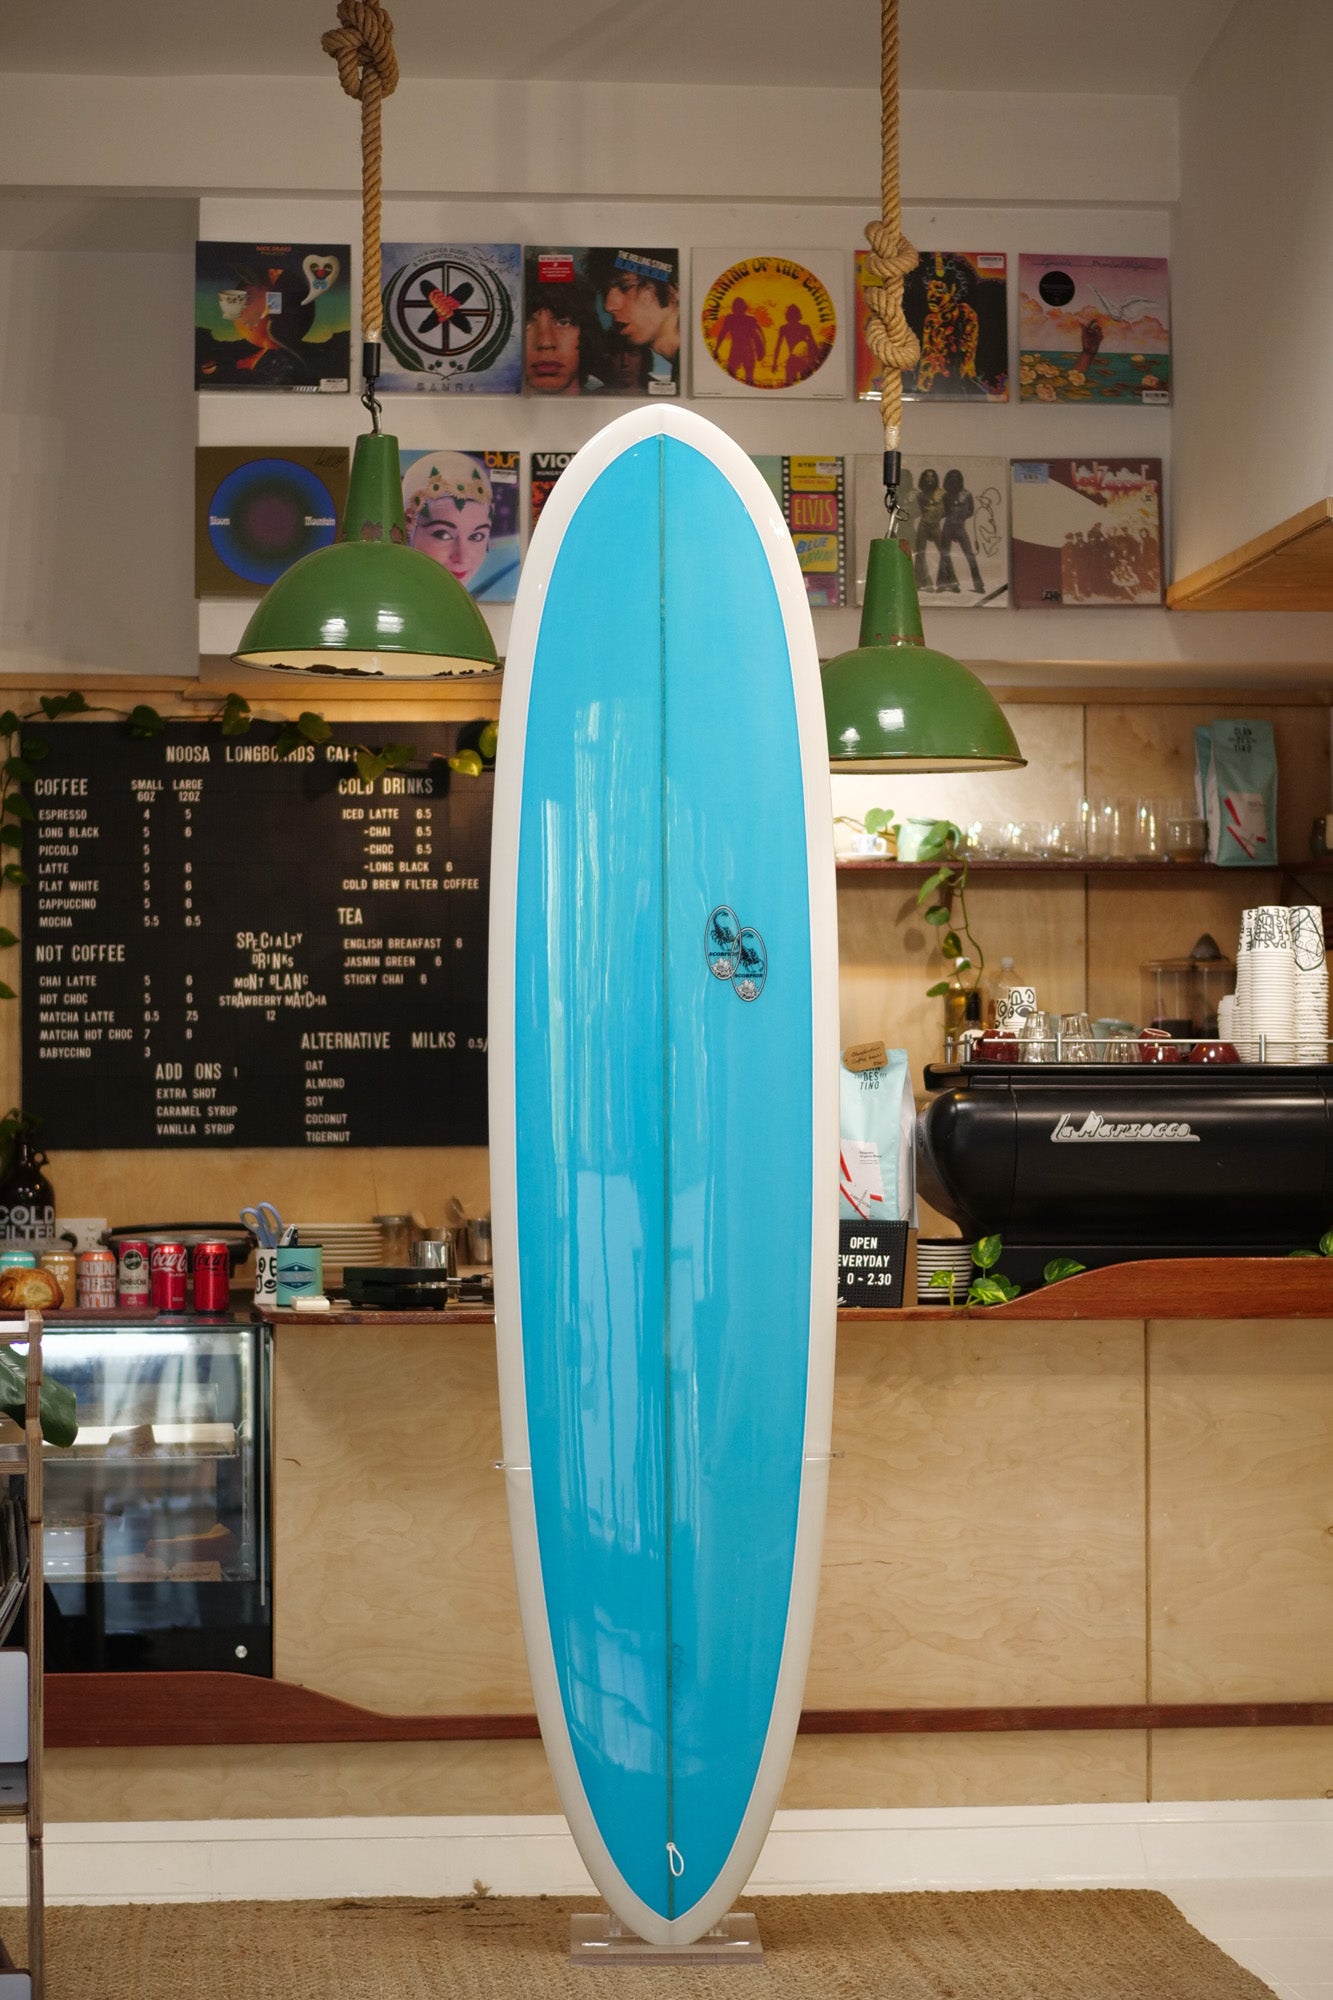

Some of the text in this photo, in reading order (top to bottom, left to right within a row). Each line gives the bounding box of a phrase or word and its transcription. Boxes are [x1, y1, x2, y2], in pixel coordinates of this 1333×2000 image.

[752, 258, 768, 273] OF
[484, 450, 519, 468] blur
[794, 499, 834, 526] ELVIS
[166, 746, 210, 762] NOOSA
[35, 779, 88, 795] COFFEE
[131, 779, 203, 791] SMALL LARGE
[338, 779, 433, 795] COLD DRINKS
[39, 809, 191, 820] ESPRESSO 4 5
[343, 808, 431, 819] ICED LATTE 6.5
[39, 827, 191, 838] LONG BLACK 5 6
[416, 826, 431, 837] 6.5
[39, 844, 150, 856] PICCOLO 5
[417, 844, 432, 854] 6.5
[39, 862, 192, 874] LATTE 5 6
[399, 862, 429, 872] BLACK
[446, 862, 453, 872] 6
[39, 880, 192, 892] FLAT WHITE 5 6
[343, 878, 478, 890] COLD BREW FILTER COFFEE
[39, 898, 192, 909] CAPPUCCINO 5 6
[40, 915, 201, 927] MOCHA 5.5 6.5
[338, 908, 362, 924] TEA
[237, 932, 303, 950] SPECIALTY
[344, 938, 462, 949] ENGLISH BREAKFAST 6
[36, 945, 125, 962] NOT COFFEE
[252, 951, 293, 969] DRINKS
[344, 956, 441, 967] JASMIN GREEN 6
[40, 975, 193, 986] CHAI LATTE 5 6
[234, 973, 308, 990] MONT BLANC
[344, 974, 427, 985] STICKY CHAI 6
[40, 993, 193, 1005] HOT CHOC 5 6
[220, 992, 281, 1008] STRAWBERRY
[40, 1012, 79, 1022] MATCHA
[85, 1011, 114, 1022] LATTE
[144, 1011, 159, 1022] 6.5
[267, 1010, 276, 1021] 12
[40, 1030, 79, 1040] MATCHA
[85, 1029, 102, 1040] HOT
[109, 1029, 132, 1040] CHOC
[145, 1029, 150, 1039] 7
[301, 1032, 390, 1049] ALTERNATIVE
[412, 1032, 455, 1048] MILKS
[40, 1047, 150, 1058] BABYCCINO 3
[305, 1060, 323, 1071] OAT
[156, 1063, 182, 1080] ADD
[196, 1063, 221, 1079] ONS
[863, 1071, 879, 1082] DES
[306, 1078, 344, 1089] ALMOND
[860, 1080, 880, 1091] TINO
[157, 1088, 216, 1099] EXTRA SHOT
[306, 1096, 323, 1106] SOY
[157, 1106, 237, 1116] CARAMEL SYRUP
[306, 1113, 347, 1124] COCONUT
[157, 1124, 234, 1135] VANILLA SYRUP
[306, 1131, 350, 1142] TIGERNUT
[850, 1236, 878, 1250] OPEN
[867, 1273, 892, 1286] 2.30
